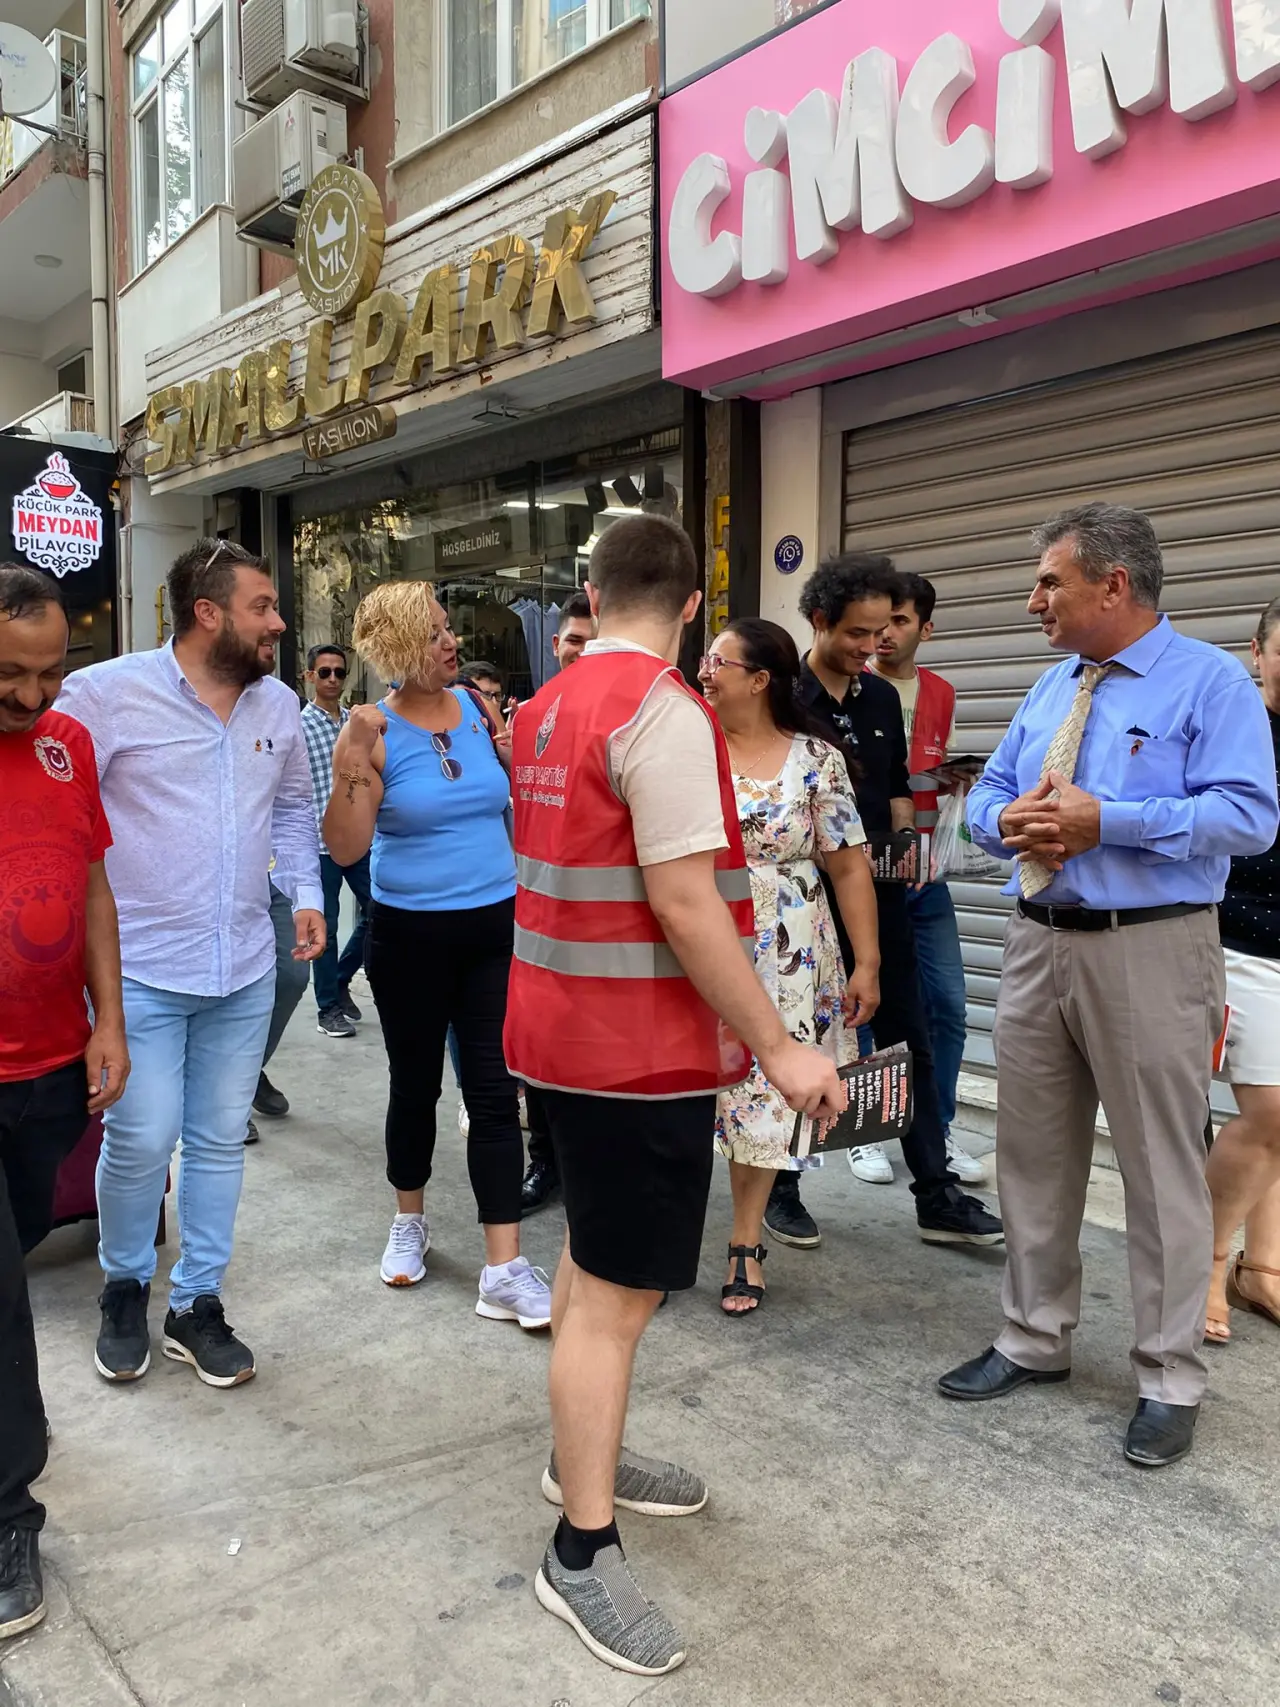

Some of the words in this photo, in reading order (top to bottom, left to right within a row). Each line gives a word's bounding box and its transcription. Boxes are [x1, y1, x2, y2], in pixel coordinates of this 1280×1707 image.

[298, 169, 365, 241] SMALLPARK
[318, 240, 350, 283] MK
[308, 271, 361, 313] FASHION
[143, 188, 618, 476] SMALLPARK
[306, 413, 380, 454] FASHION
[17, 498, 62, 514] KÜÇÜK
[65, 505, 98, 518] PARK
[18, 510, 98, 542] MEYDAN
[19, 535, 97, 556] PİLAVCISI
[442, 529, 501, 557] HOŞGELDİNİZ
[854, 1087, 865, 1130] SOLCUYUZ;
[865, 1085, 873, 1110] SAĞCI
[889, 1087, 898, 1120] Kurduğu
